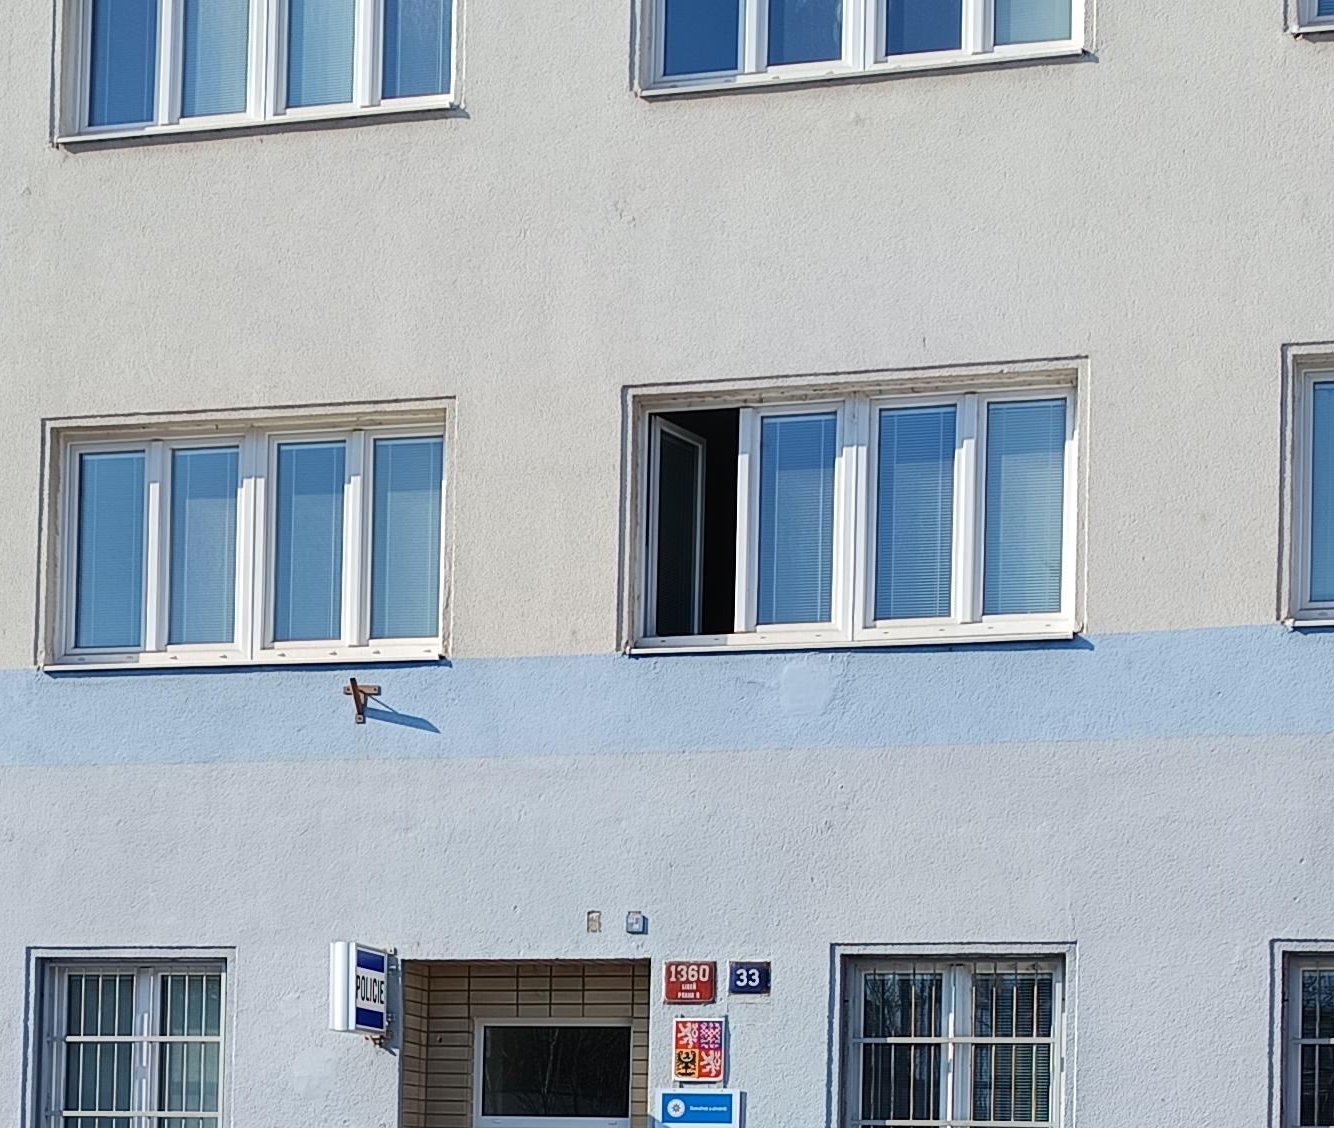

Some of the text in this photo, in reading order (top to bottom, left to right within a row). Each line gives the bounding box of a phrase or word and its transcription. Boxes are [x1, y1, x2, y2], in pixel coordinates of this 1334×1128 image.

[670, 965, 709, 982] 1360
[736, 968, 760, 987] 33
[356, 974, 385, 1005] POLICIE
